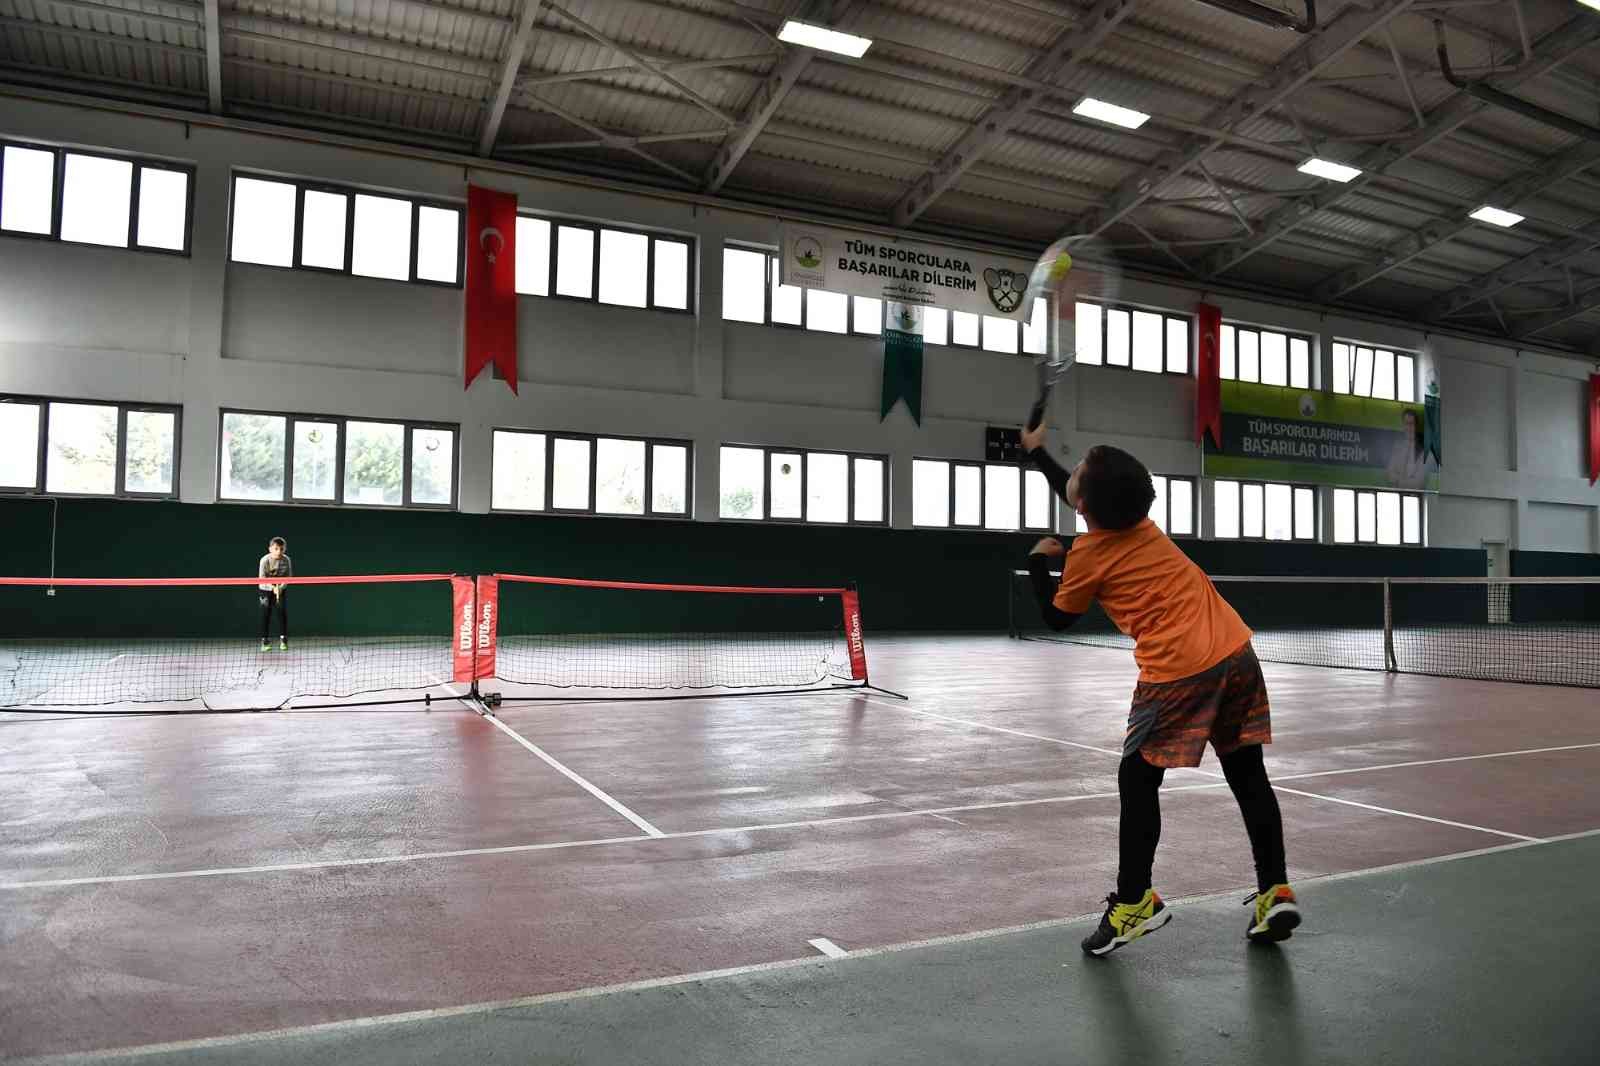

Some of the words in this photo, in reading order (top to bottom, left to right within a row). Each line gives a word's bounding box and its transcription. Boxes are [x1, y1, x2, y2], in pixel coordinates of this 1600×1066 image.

[845, 240, 875, 257] TÜM
[879, 247, 972, 273] SPORCULARA
[838, 258, 919, 282] BAŞARILAR
[923, 271, 976, 291] DİLERİM
[1242, 437, 1317, 457] BAŞARILAR
[1320, 443, 1369, 462] DİLERİM
